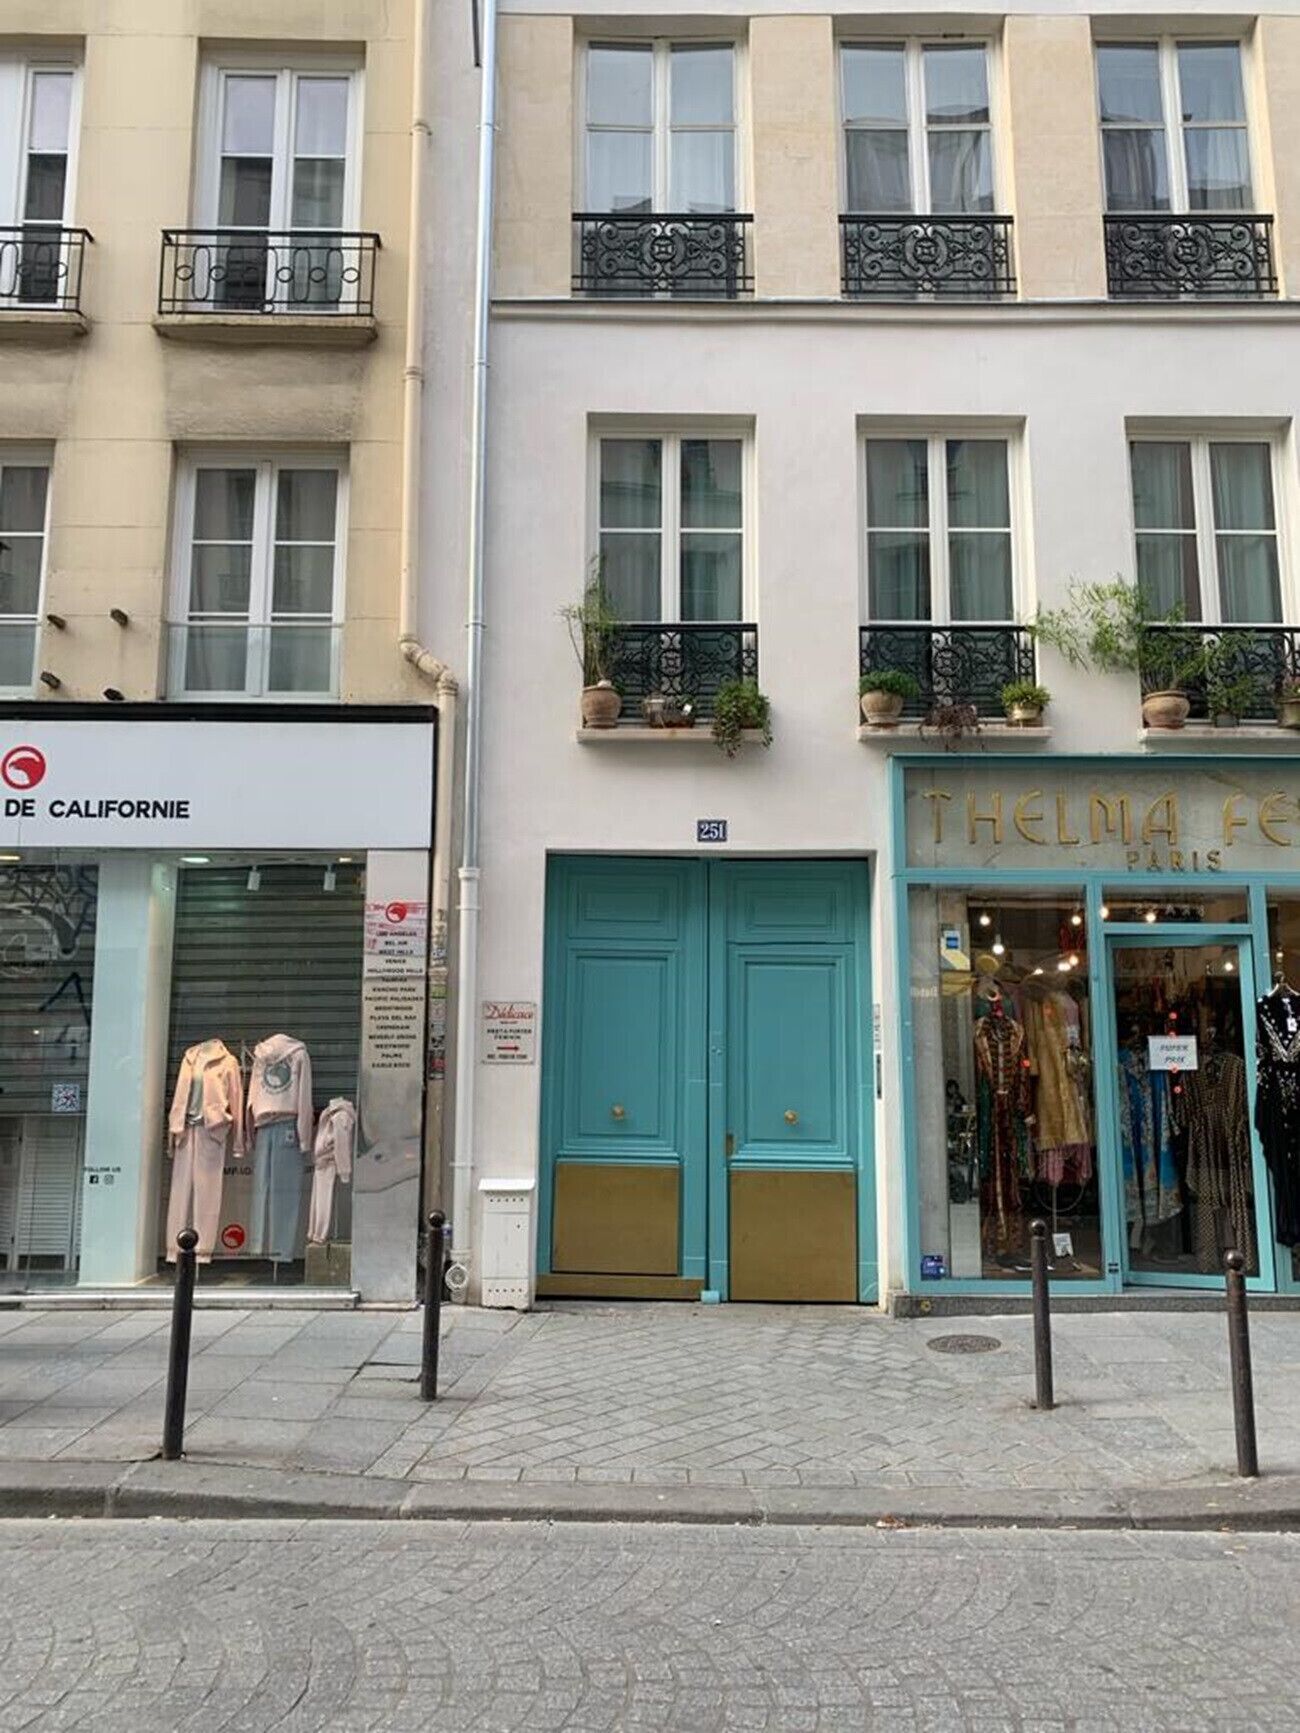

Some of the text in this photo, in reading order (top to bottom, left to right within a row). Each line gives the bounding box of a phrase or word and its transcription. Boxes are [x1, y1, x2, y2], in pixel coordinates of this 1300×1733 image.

[4, 799, 190, 818] DE CALIFORNIE
[921, 789, 1177, 846] THELMA
[700, 823, 724, 839] 251
[1126, 851, 1222, 873] PARIS
